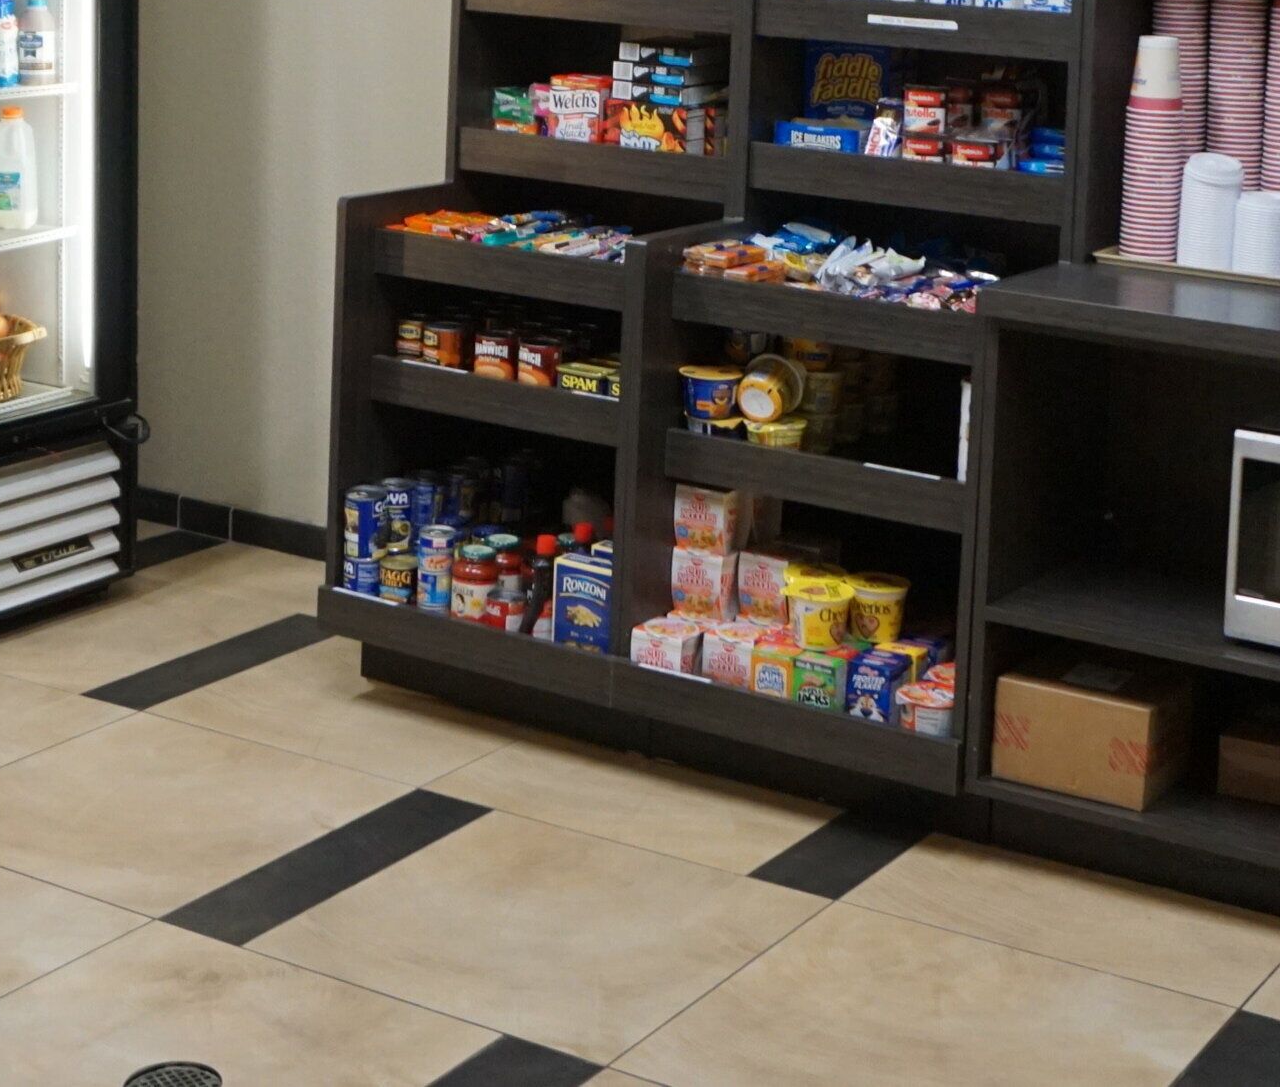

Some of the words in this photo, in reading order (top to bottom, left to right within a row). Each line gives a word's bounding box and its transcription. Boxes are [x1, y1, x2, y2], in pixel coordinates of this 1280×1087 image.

[817, 53, 882, 80] fiddle
[552, 90, 598, 110] Welch's
[811, 77, 881, 105] faddle
[790, 130, 805, 145] ICE
[805, 131, 842, 151] BREAKERS
[561, 374, 597, 393] SPAM
[562, 577, 607, 602] RONZONI
[797, 692, 830, 707] JACKS
